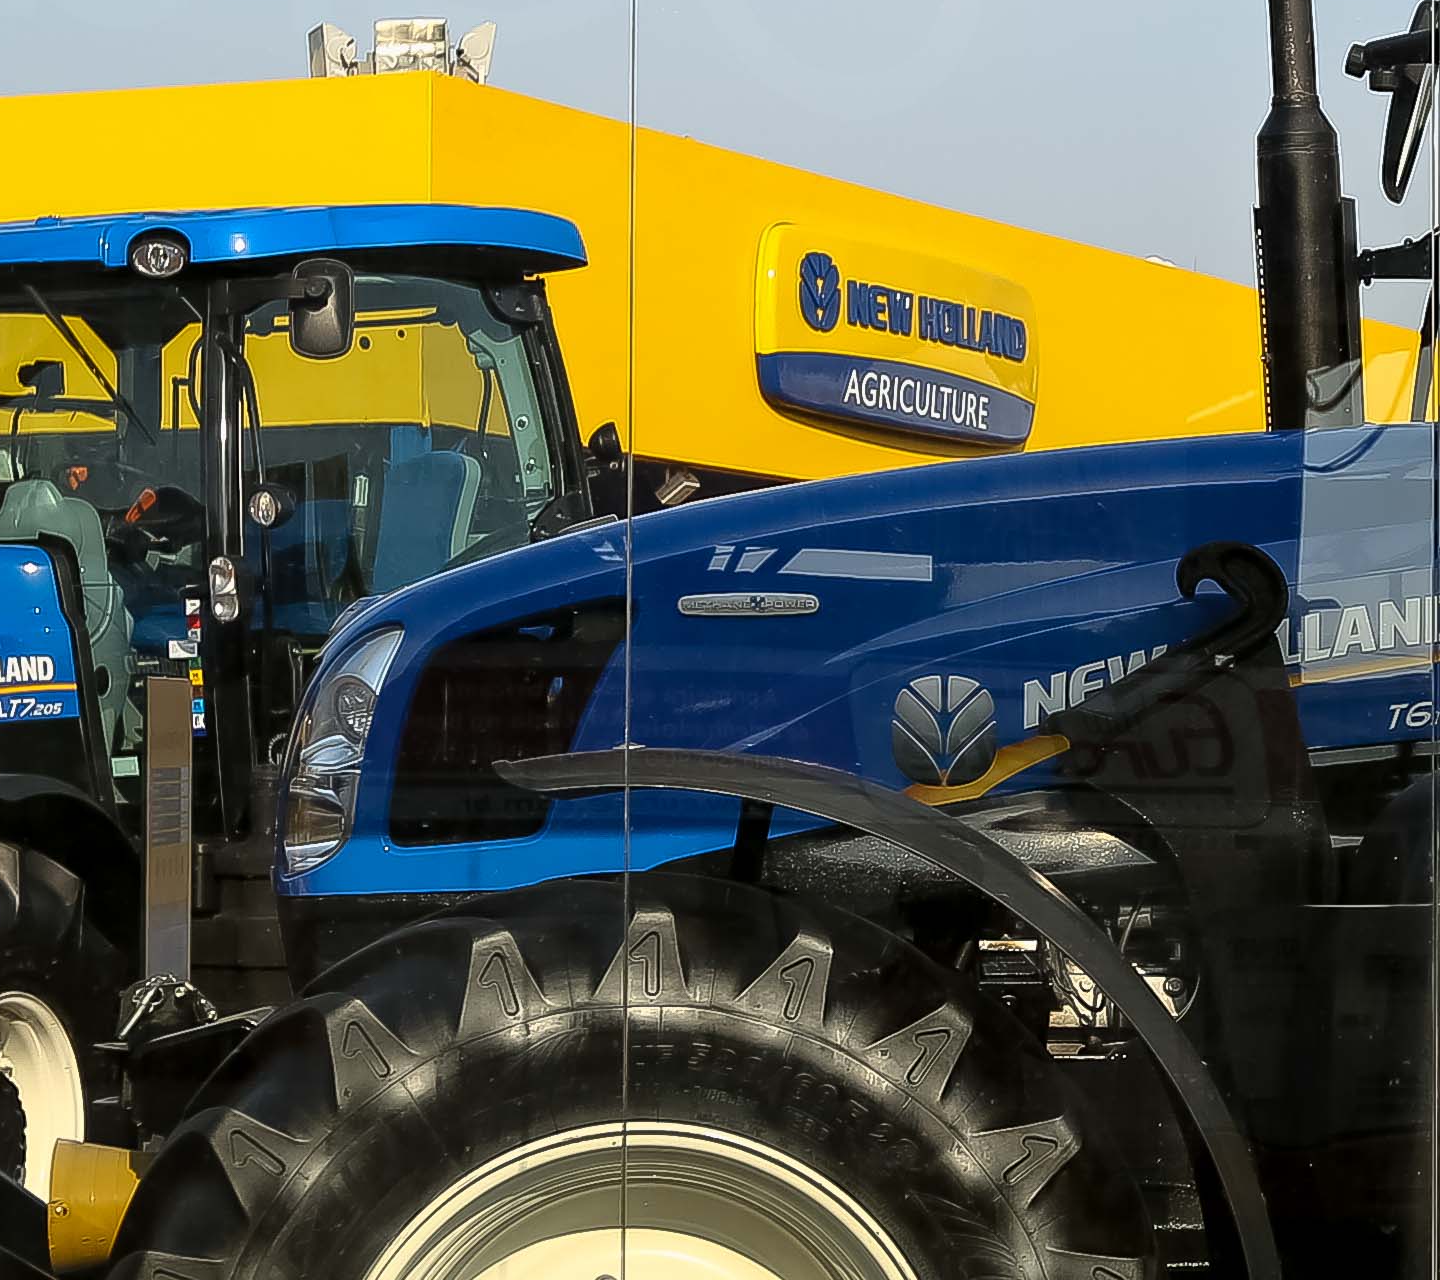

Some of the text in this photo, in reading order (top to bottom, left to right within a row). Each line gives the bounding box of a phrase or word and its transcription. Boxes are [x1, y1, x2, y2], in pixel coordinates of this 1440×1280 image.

[847, 280, 1026, 362] NEW HOLLAND
[844, 369, 989, 430] AGRICULTURE
